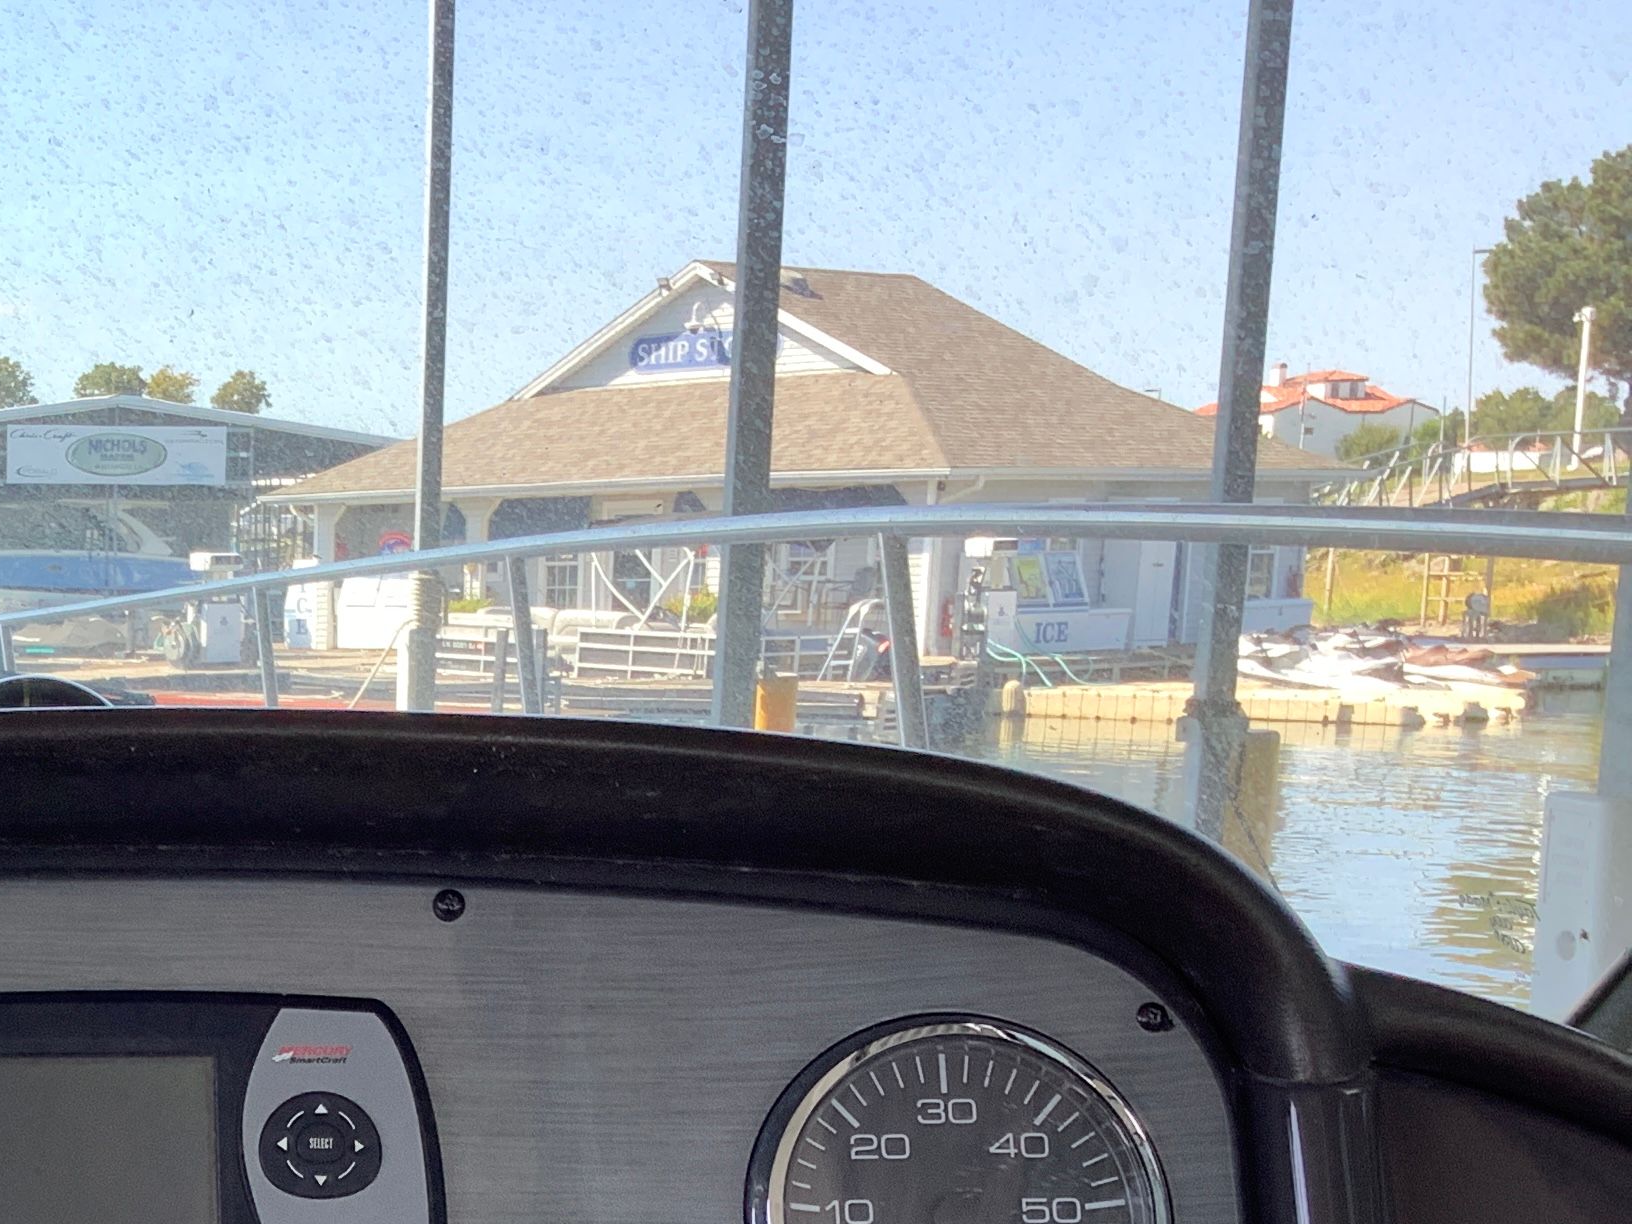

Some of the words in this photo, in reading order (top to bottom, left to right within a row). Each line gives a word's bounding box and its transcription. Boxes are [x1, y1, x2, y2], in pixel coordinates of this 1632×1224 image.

[637, 341, 689, 366] SHIP
[88, 439, 147, 455] NICHOLS
[1034, 622, 1068, 644] ICE
[917, 1099, 977, 1124] 30
[309, 1137, 333, 1149] SELECT
[850, 1134, 911, 1160] 20
[989, 1133, 1050, 1158] 40
[825, 1200, 874, 1224] 10
[1022, 1198, 1082, 1224] 50
